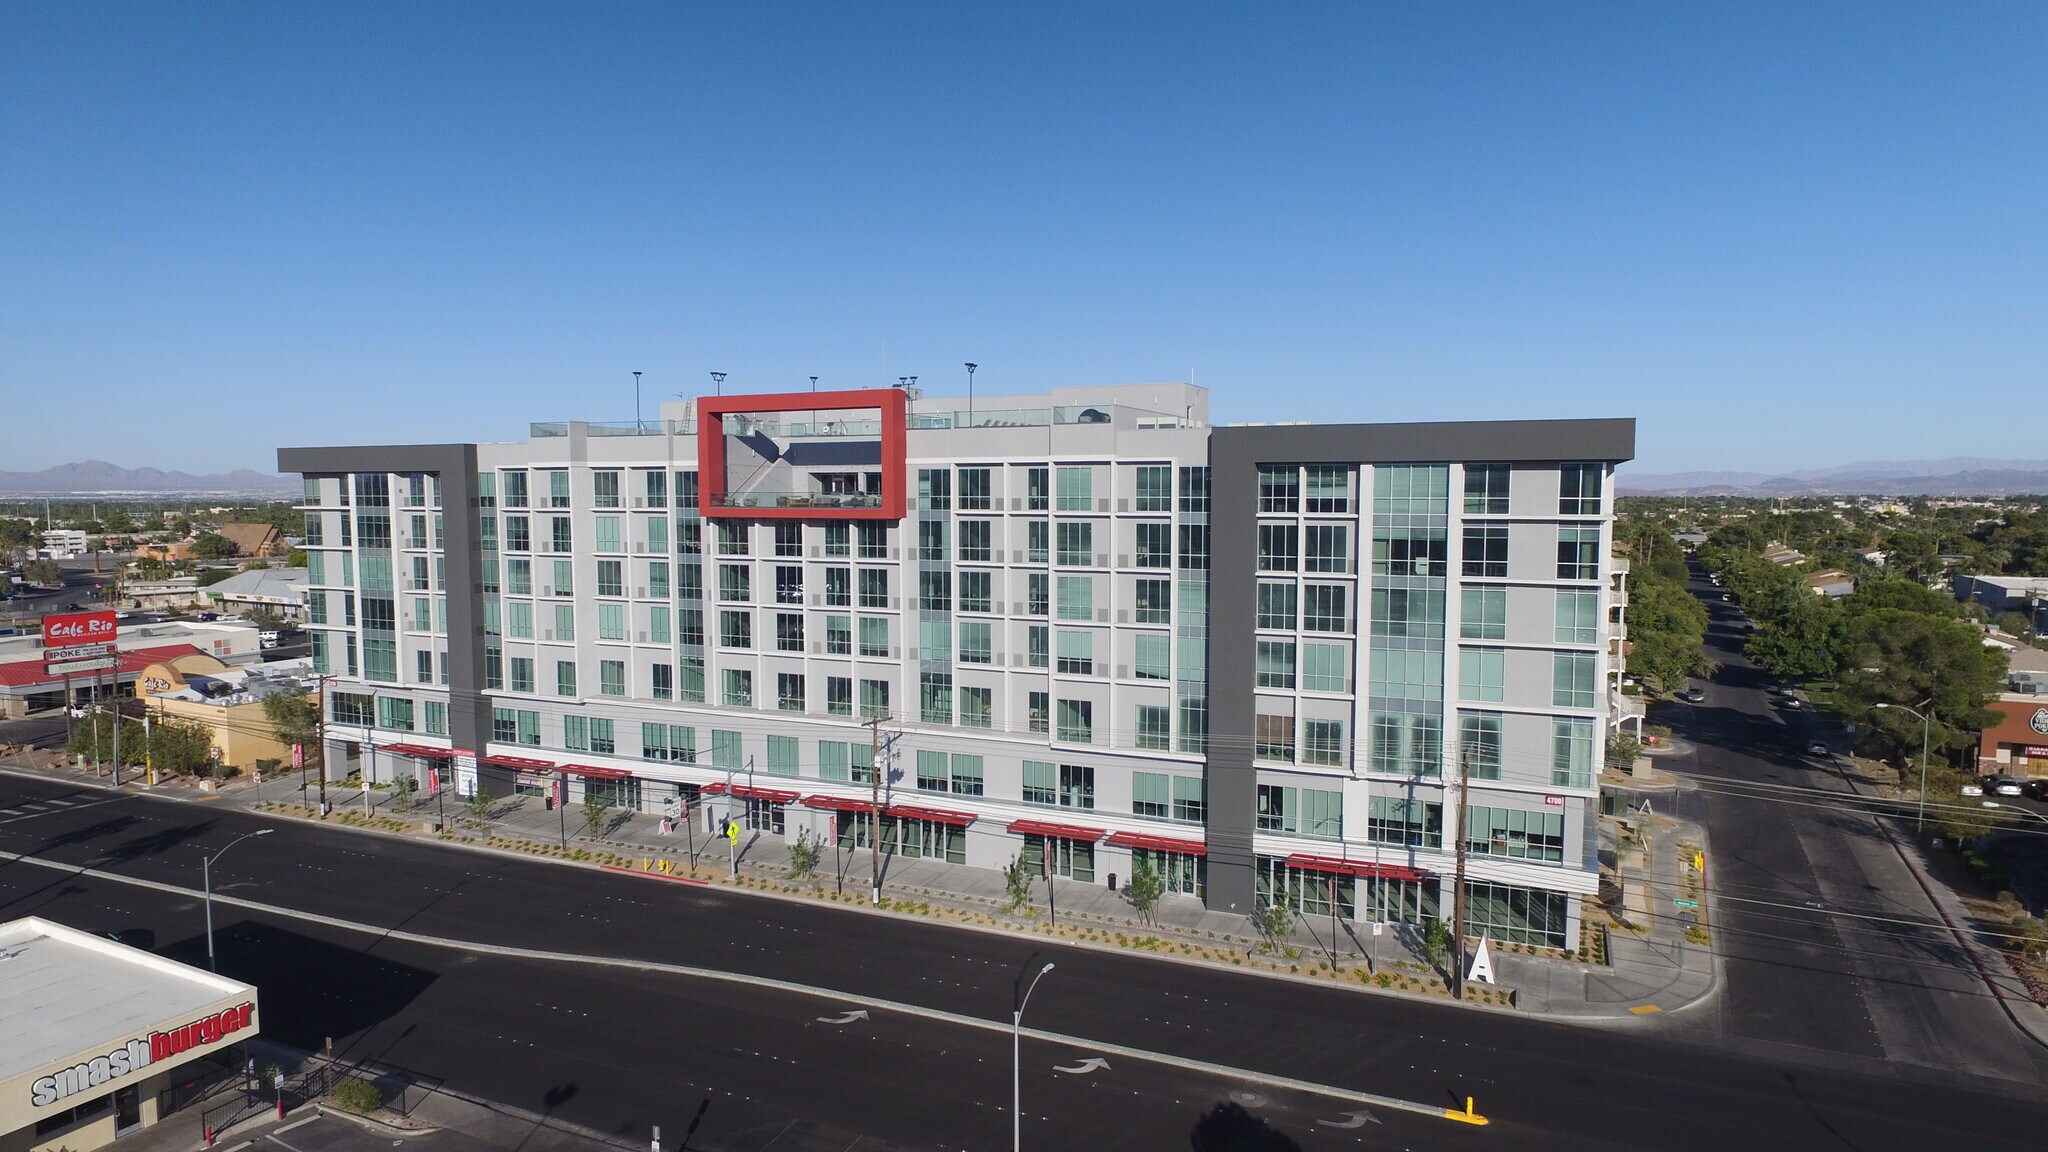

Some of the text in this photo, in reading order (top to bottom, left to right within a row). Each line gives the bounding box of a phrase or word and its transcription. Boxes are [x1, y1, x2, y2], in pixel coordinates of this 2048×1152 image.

[50, 621, 84, 637] Cafe
[53, 649, 82, 659] POKE
[1546, 796, 1562, 805] 4700
[672, 808, 680, 817] 30
[31, 1001, 255, 1107] smashburger
